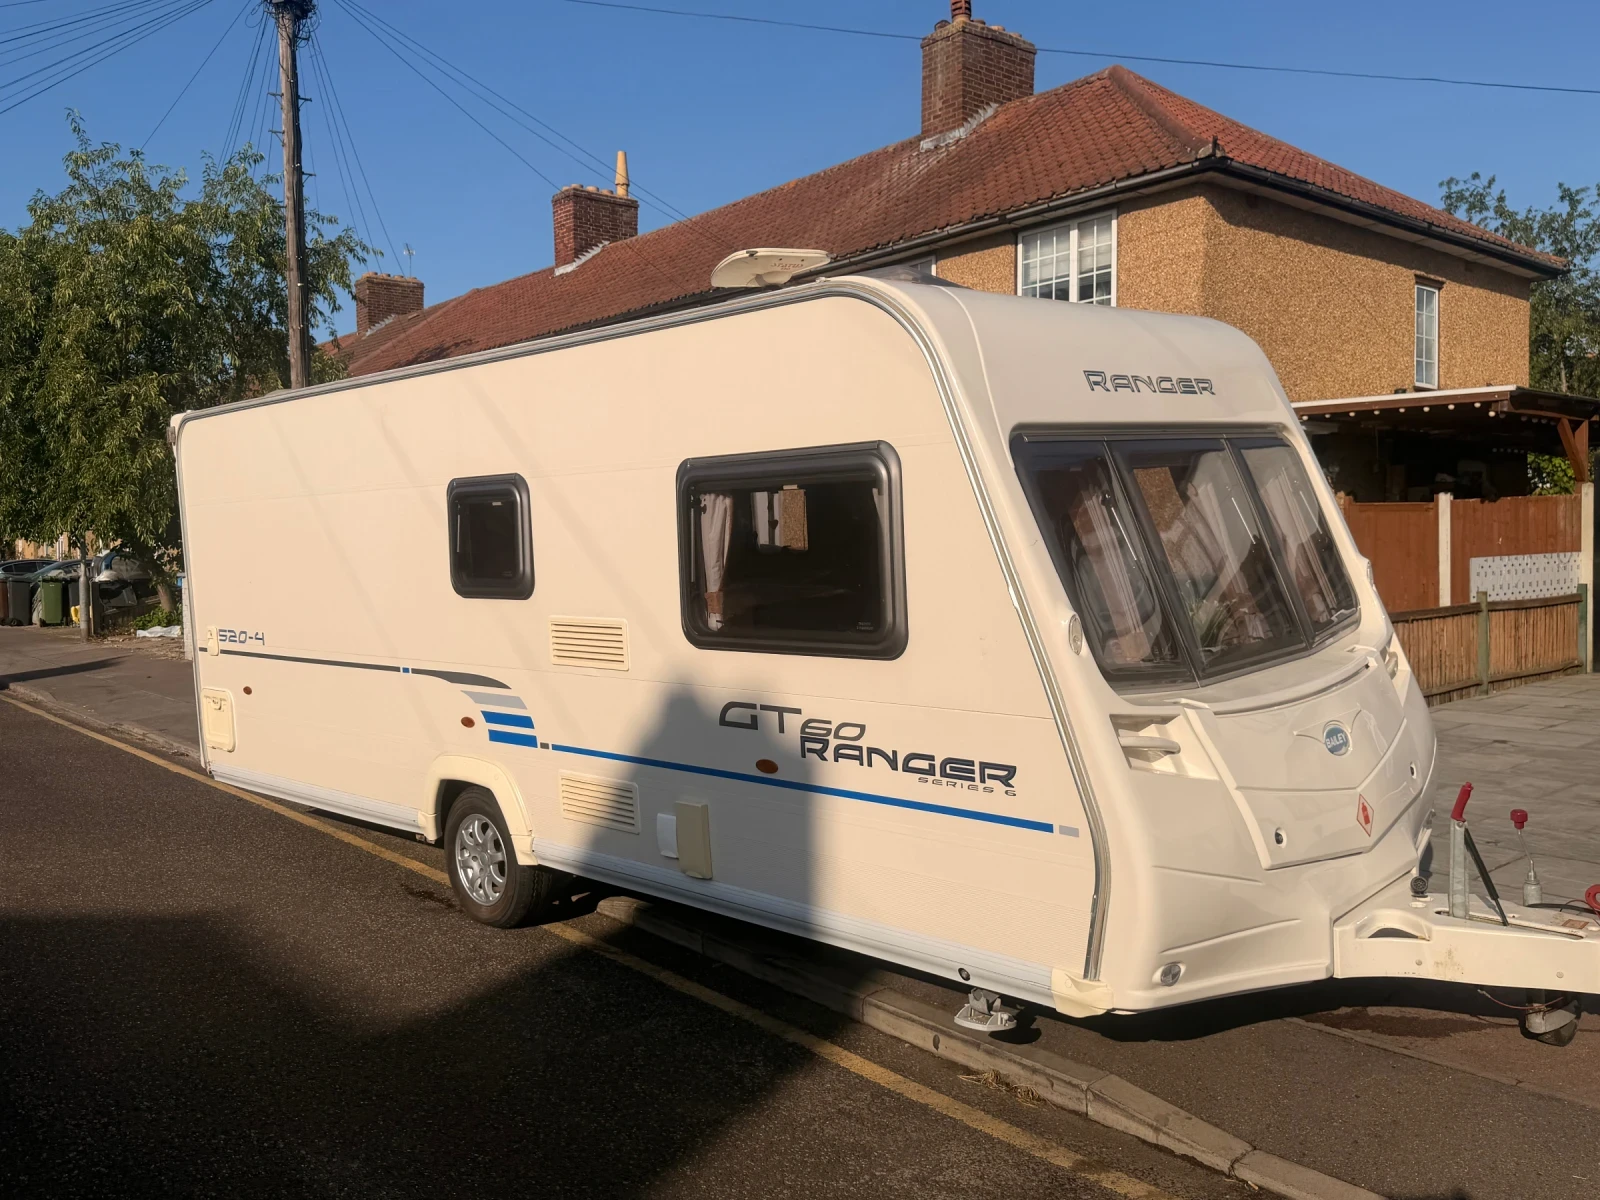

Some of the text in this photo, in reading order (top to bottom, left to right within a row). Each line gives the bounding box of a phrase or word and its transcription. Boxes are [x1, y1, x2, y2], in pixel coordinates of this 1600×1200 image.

[1083, 369, 1216, 395] RANGER
[218, 629, 265, 646] 520-4
[1325, 732, 1347, 749] BAILEY
[800, 736, 1017, 788] RANGER
[918, 776, 1017, 797] SERIES 6
